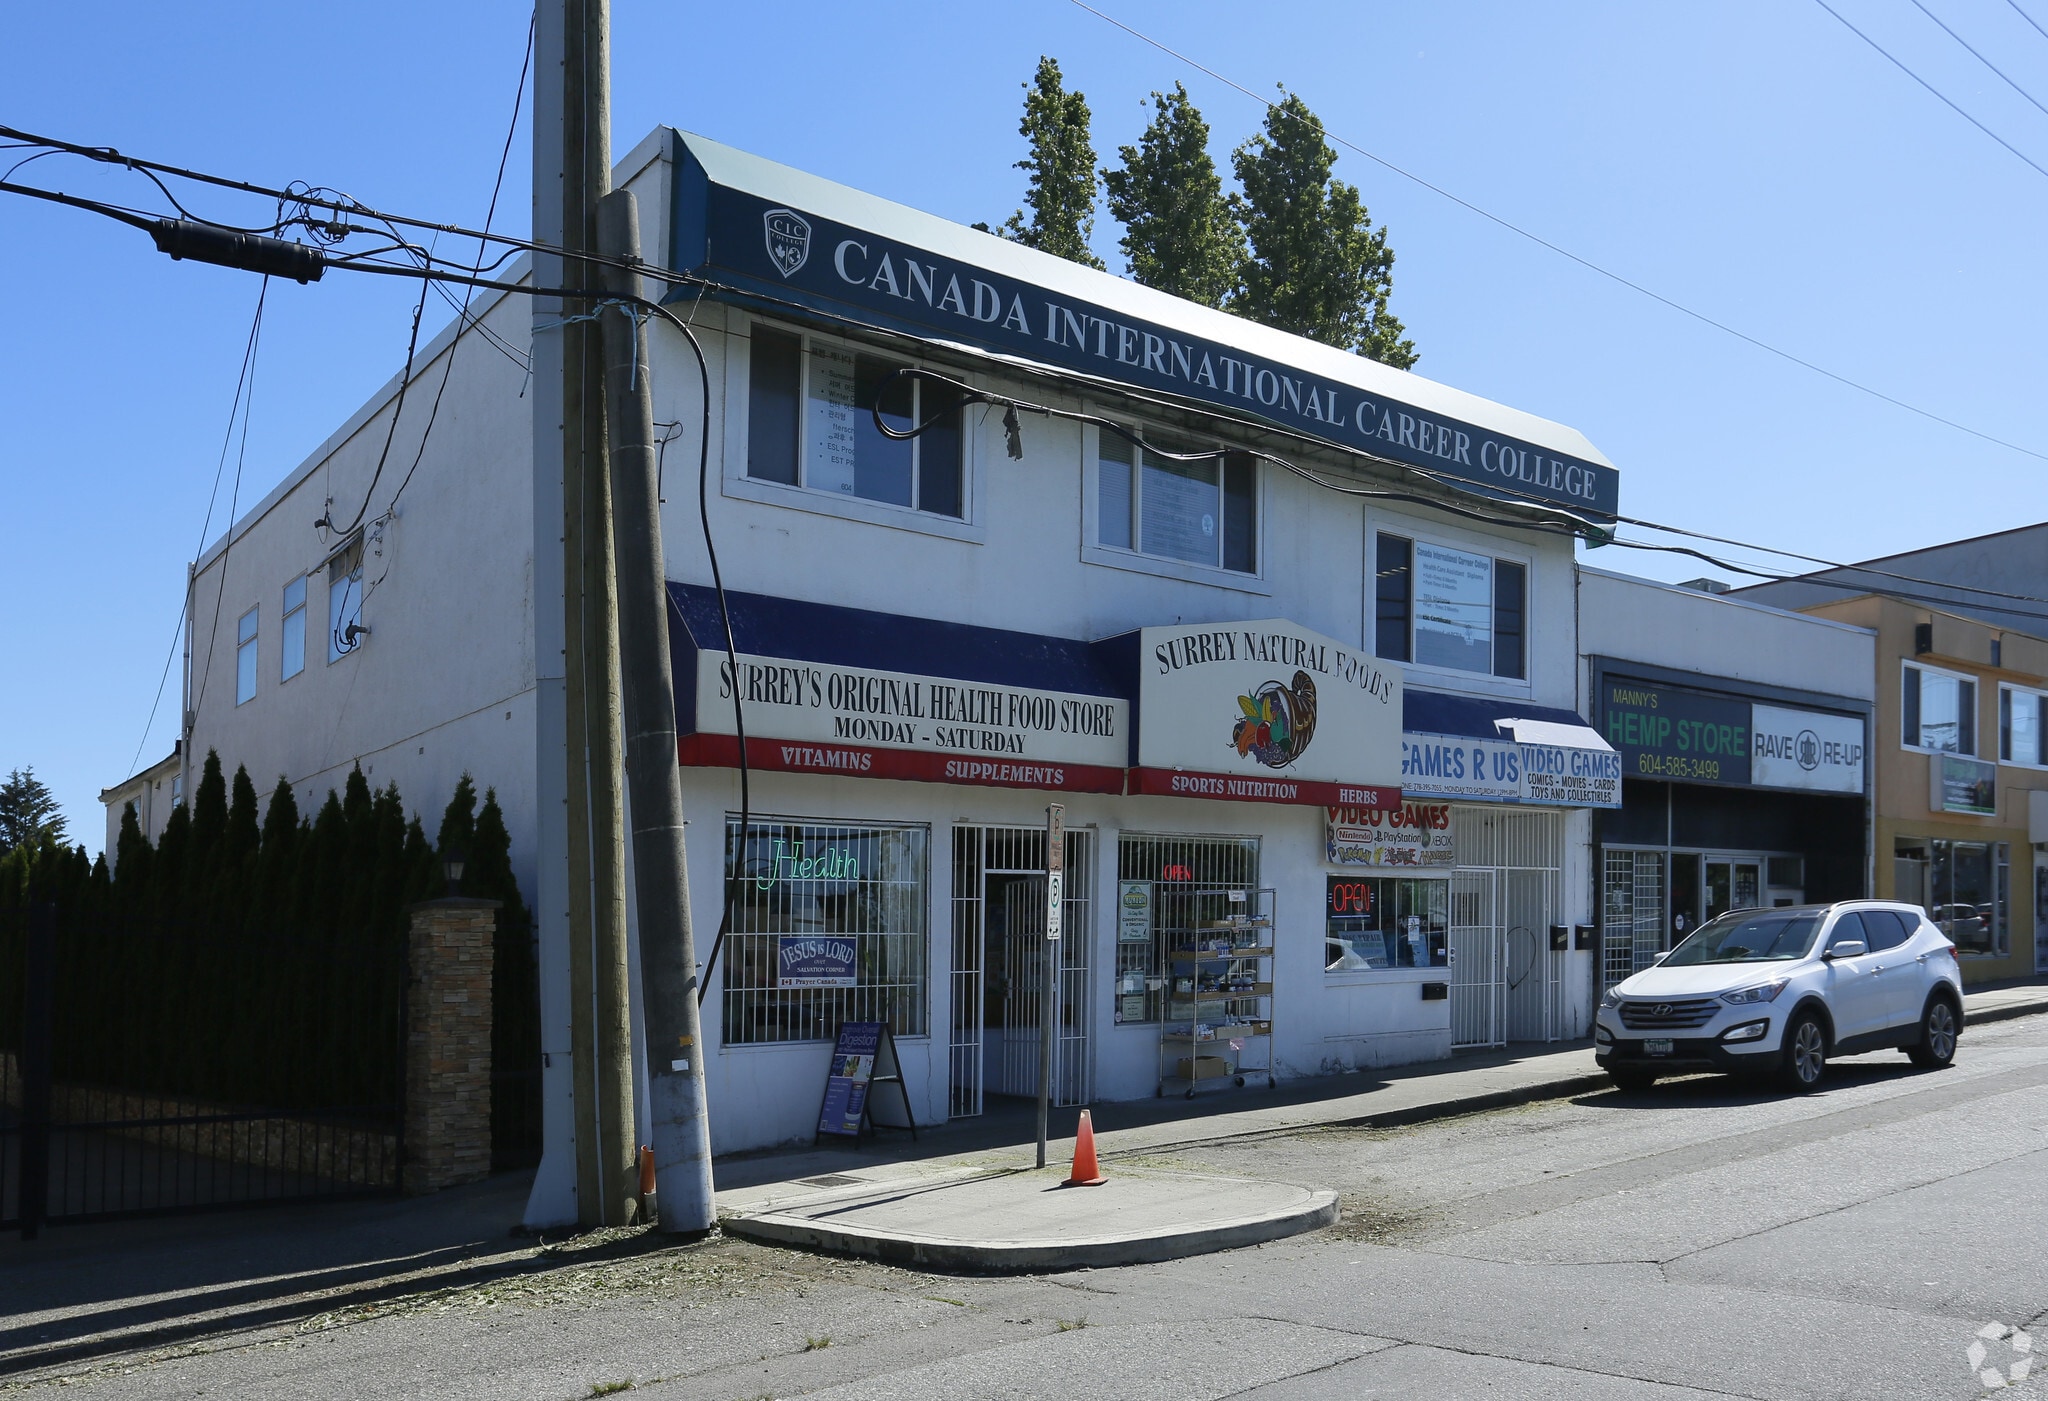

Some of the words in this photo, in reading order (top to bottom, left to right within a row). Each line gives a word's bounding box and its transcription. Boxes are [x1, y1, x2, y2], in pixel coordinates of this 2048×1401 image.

[772, 233, 803, 245] COLLEGE
[774, 219, 802, 236] CIC
[834, 240, 1031, 336] CANADA
[1044, 302, 1346, 427] INTERNATIONAL
[1355, 401, 1471, 466] CAREER
[1480, 440, 1596, 501] COLLEGE
[828, 443, 839, 452] ESL
[831, 456, 843, 465] EST
[1155, 632, 1237, 676] SURREY
[1243, 632, 1328, 674] NATURAL
[1333, 650, 1393, 705] FOODS
[720, 661, 822, 707] SURREY'S
[828, 673, 925, 718] ORIGINAL
[930, 684, 1003, 726] HEALTH
[1008, 693, 1056, 730] FOOD
[1061, 699, 1114, 737] STORE
[1613, 688, 1658, 709] MANNY'S
[834, 716, 917, 744] MONDAY
[935, 726, 1026, 754] SATURDAY
[1608, 710, 1671, 748] HEMP
[1677, 719, 1746, 757] STORE
[781, 746, 872, 771] VITAMINS
[1755, 732, 1793, 760] RAVE
[1823, 741, 1862, 767] RE-UP
[945, 760, 1064, 785] SUPPLEMENTS
[1402, 742, 1465, 779] GAMES
[1473, 748, 1486, 781] R
[1494, 749, 1519, 783] US
[1521, 746, 1565, 774] VIDEO
[1571, 751, 1620, 779] GAMES
[1639, 753, 1720, 779] 604-585-3499
[1171, 776, 1224, 794] SPORTS
[1227, 779, 1298, 799] NUTRITION
[1443, 785, 1464, 793] MONDAY
[1473, 787, 1496, 795] SATURDAY
[1528, 773, 1553, 786] COMICS
[1561, 777, 1587, 789] MOVIES
[1594, 779, 1615, 790] CARDS
[1339, 788, 1378, 805] HERBS
[1531, 786, 1549, 799] TOYS
[1551, 787, 1565, 800] AND
[1567, 789, 1612, 803] COLLECTIBLES
[1327, 805, 1383, 826] VIDEO
[1389, 803, 1450, 830] GAMES
[1338, 830, 1371, 841] Nintendo
[1383, 833, 1422, 844] PlayStation
[757, 839, 858, 890] Health
[1163, 864, 1191, 880] OPEN
[1333, 883, 1370, 911] OPEN
[781, 940, 817, 971] JESUS
[817, 943, 825, 955] IS
[825, 940, 854, 964] LORD
